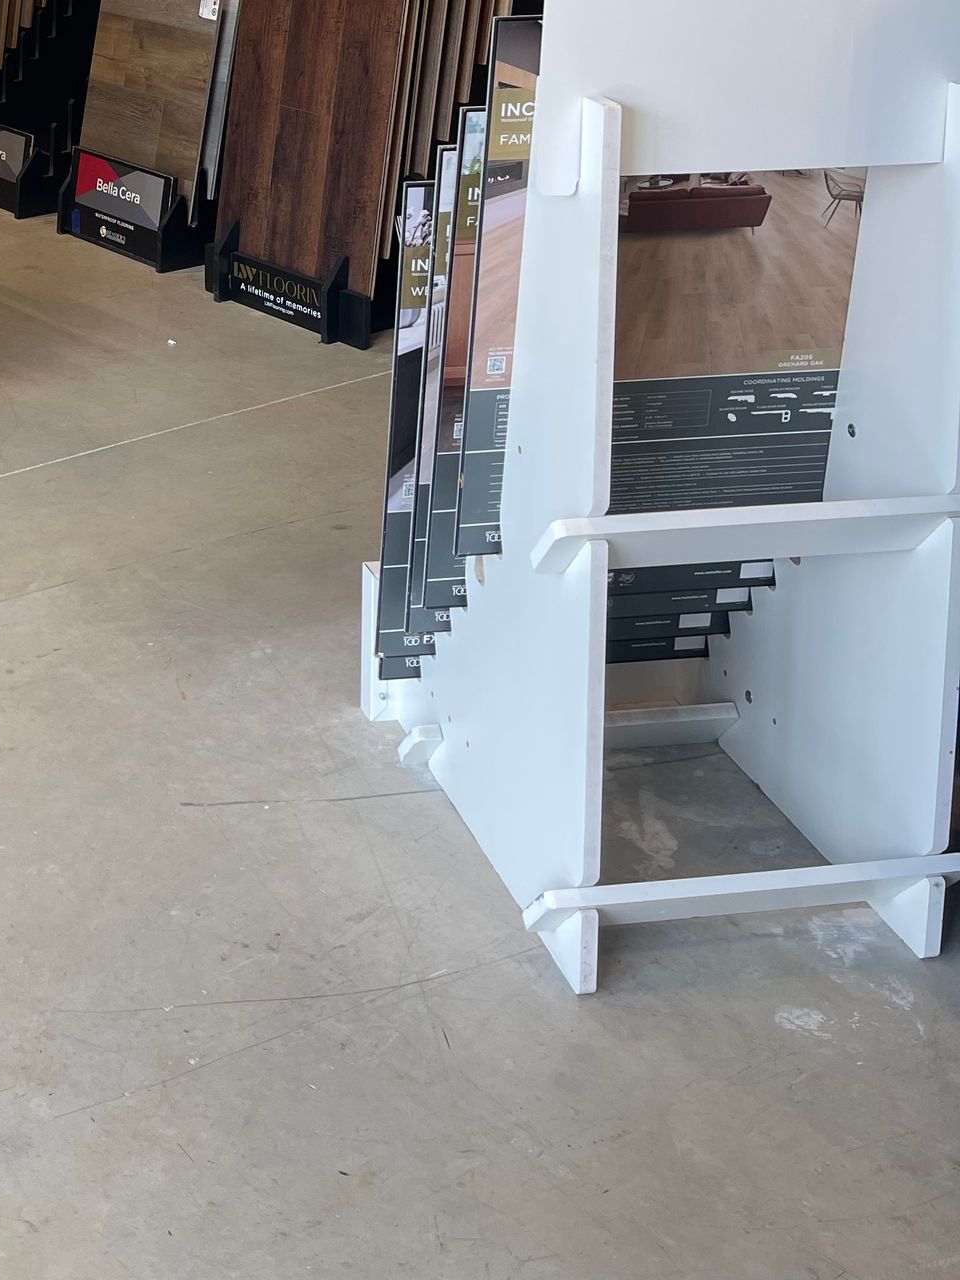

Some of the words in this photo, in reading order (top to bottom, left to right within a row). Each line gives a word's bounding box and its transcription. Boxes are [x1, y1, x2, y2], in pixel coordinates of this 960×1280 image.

[500, 102, 535, 117] INC
[500, 133, 530, 145] FAM
[96, 178, 118, 197] Bella
[119, 187, 141, 205] Cera
[411, 259, 429, 271] IN
[240, 282, 246, 291] A
[248, 284, 274, 301] lifetime
[276, 296, 284, 305] of
[286, 300, 321, 319] memories
[403, 636, 420, 646] 100
